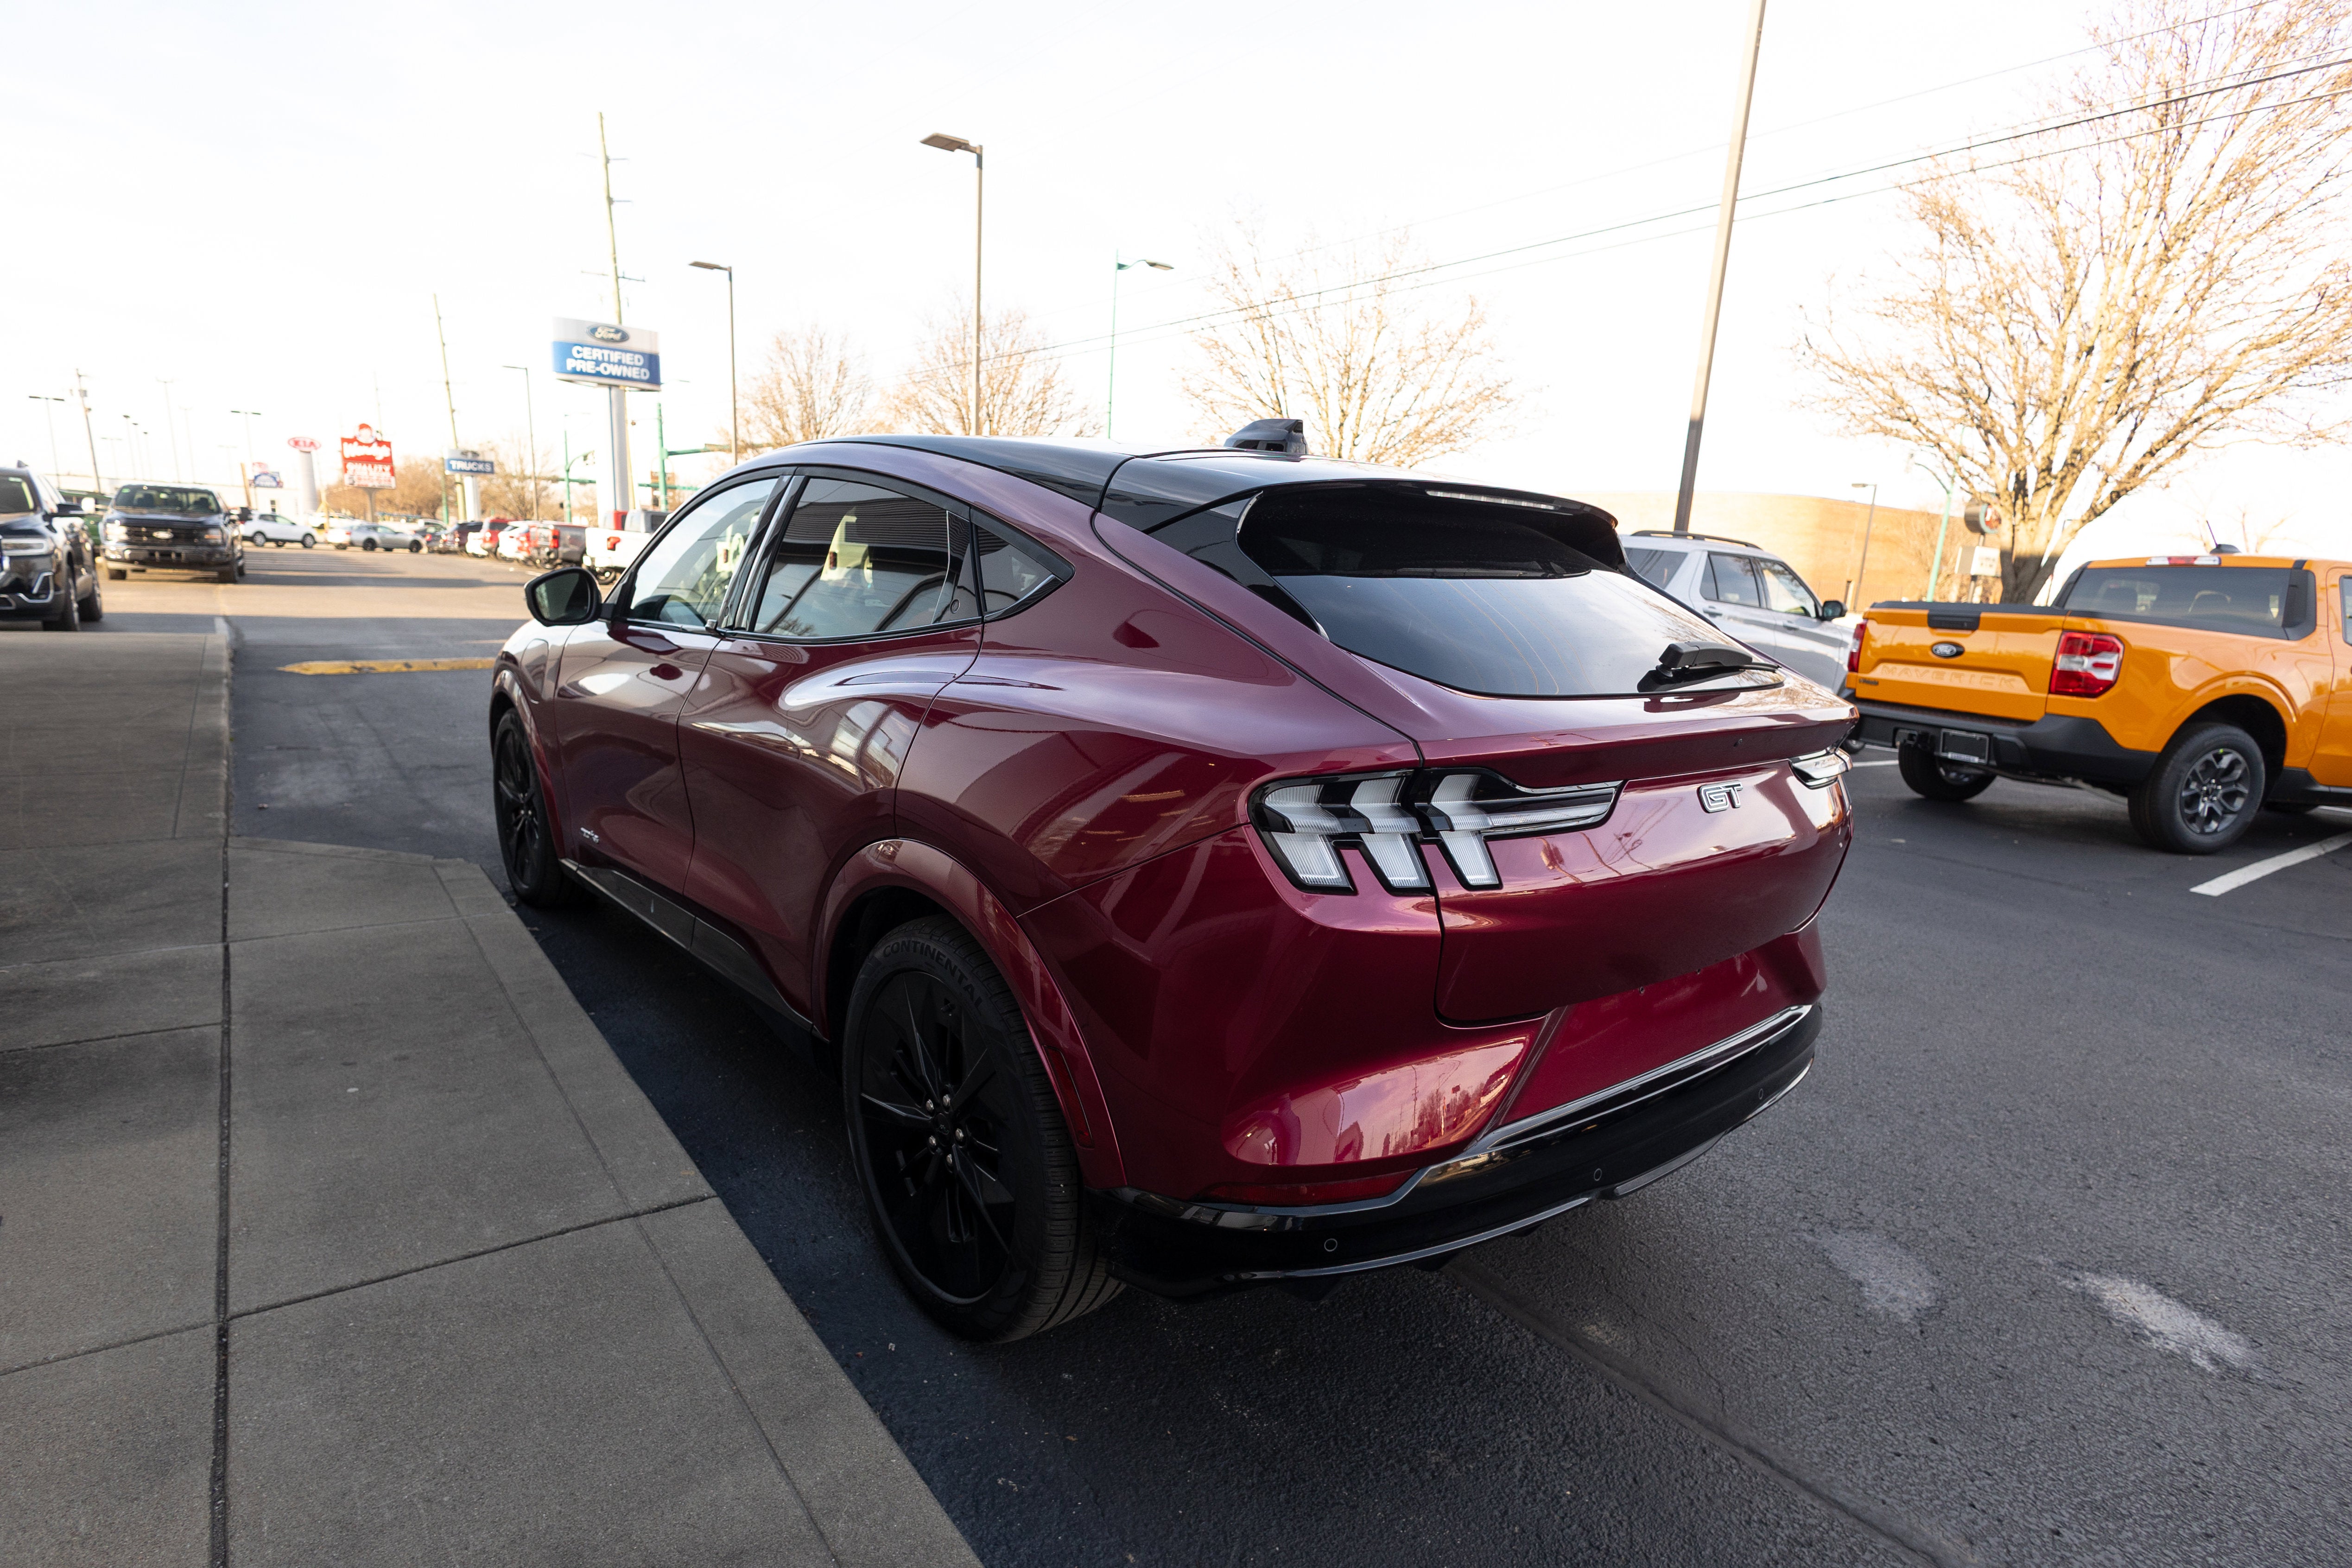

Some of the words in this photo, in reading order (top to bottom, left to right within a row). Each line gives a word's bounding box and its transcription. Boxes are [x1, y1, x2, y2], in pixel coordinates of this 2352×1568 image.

[571, 345, 644, 366] CERTIFIED
[566, 358, 650, 380] PRE-OWNED
[293, 440, 317, 449] KIA
[450, 460, 492, 472] TRUCKS
[1881, 665, 2015, 689] MAVERICK
[1697, 780, 1743, 813] GT
[883, 940, 983, 1016] CONTINENTAL
